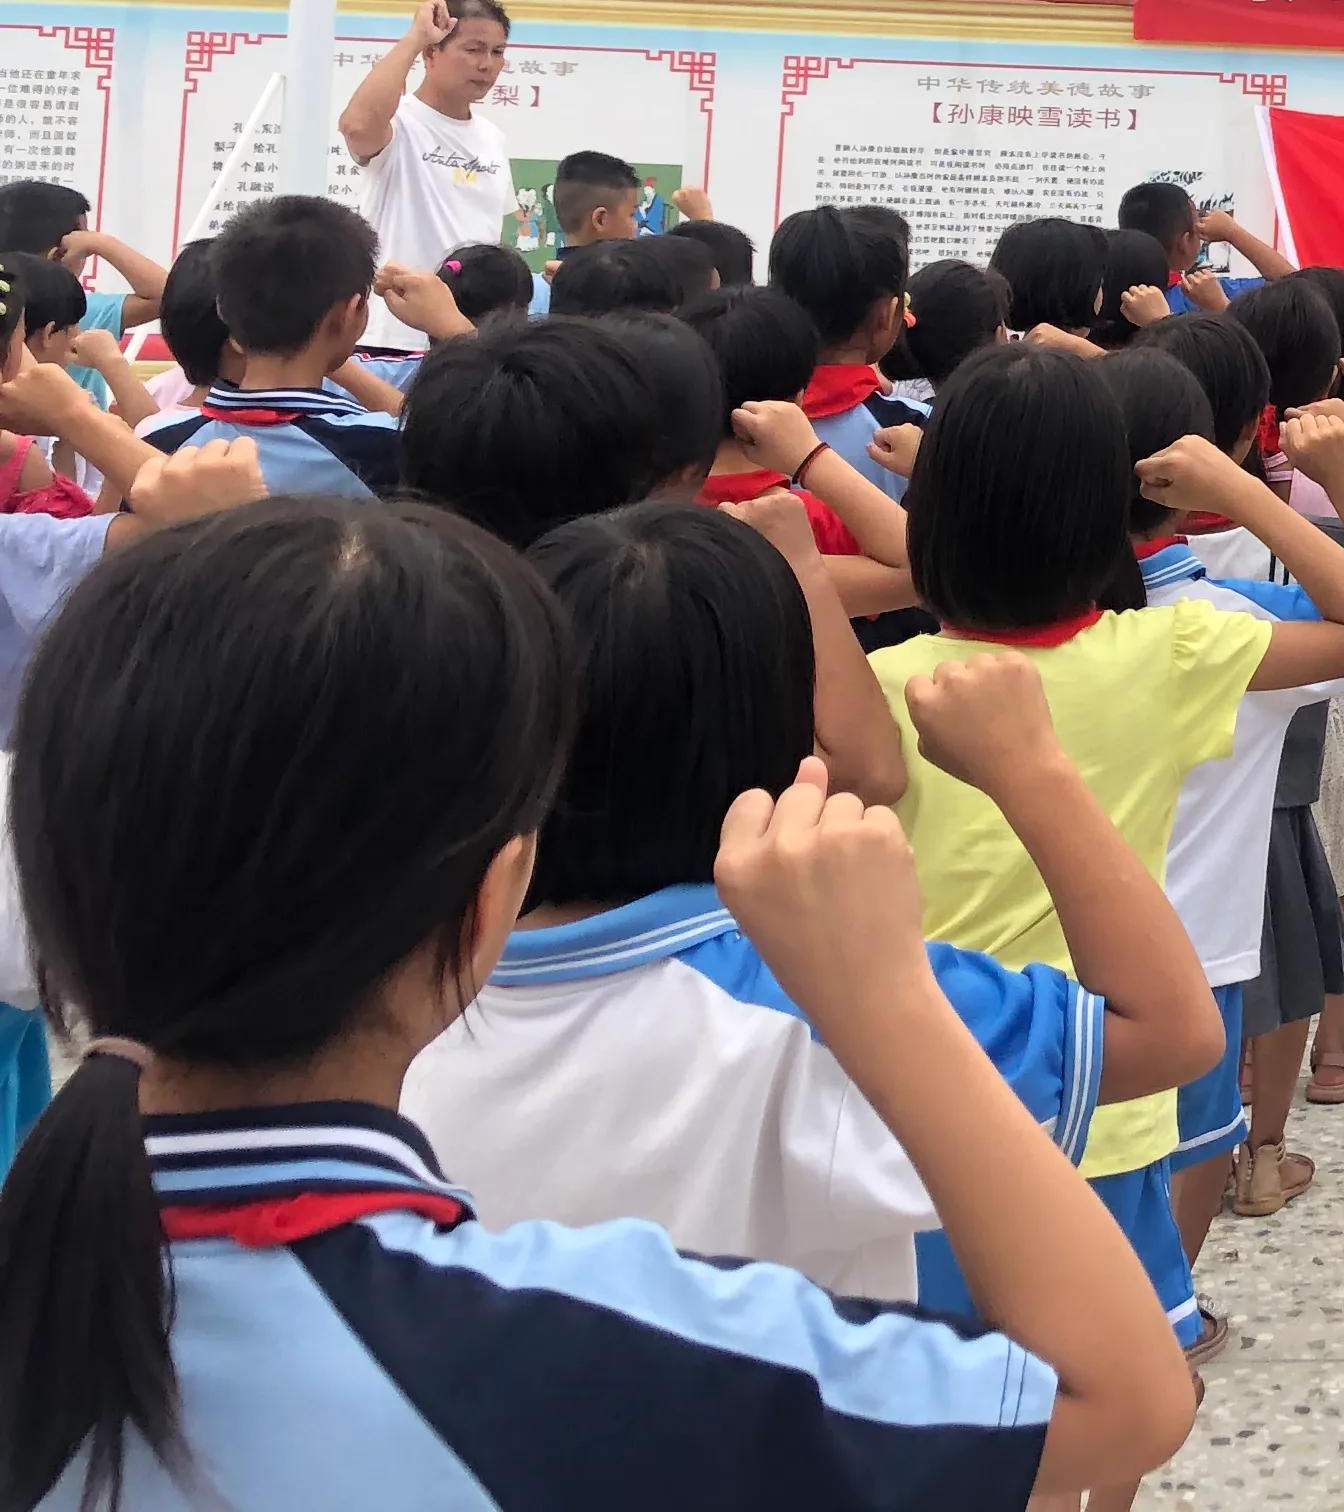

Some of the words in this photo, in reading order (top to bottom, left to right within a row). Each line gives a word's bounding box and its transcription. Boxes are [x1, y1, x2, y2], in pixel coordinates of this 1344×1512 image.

[917, 76, 1156, 99] 中华传统美德故事
[932, 102, 1137, 131] 【孙康映雪读书】
